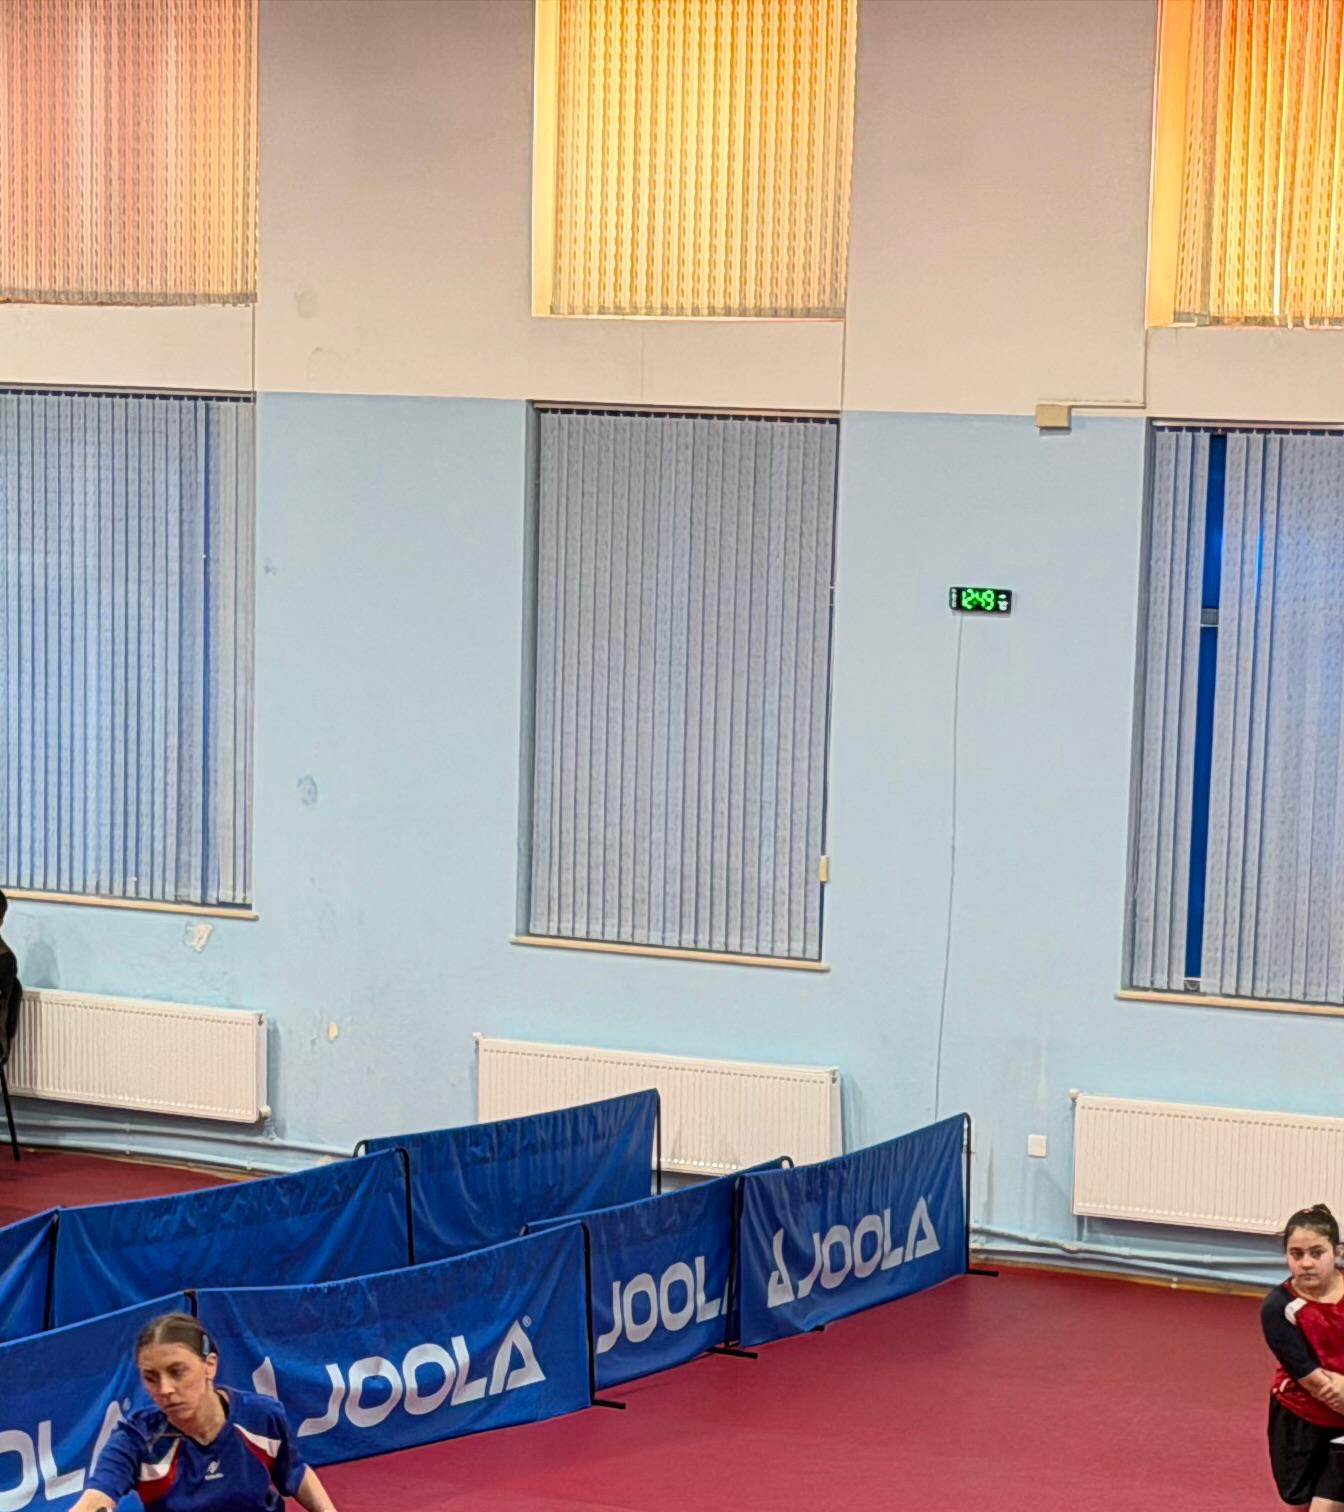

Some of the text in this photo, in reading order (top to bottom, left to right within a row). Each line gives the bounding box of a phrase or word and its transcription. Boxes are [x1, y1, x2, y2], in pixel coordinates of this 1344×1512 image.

[796, 1195, 941, 1300] JOOLA
[595, 1255, 737, 1355] JOOL
[296, 1319, 547, 1438] JOOLA
